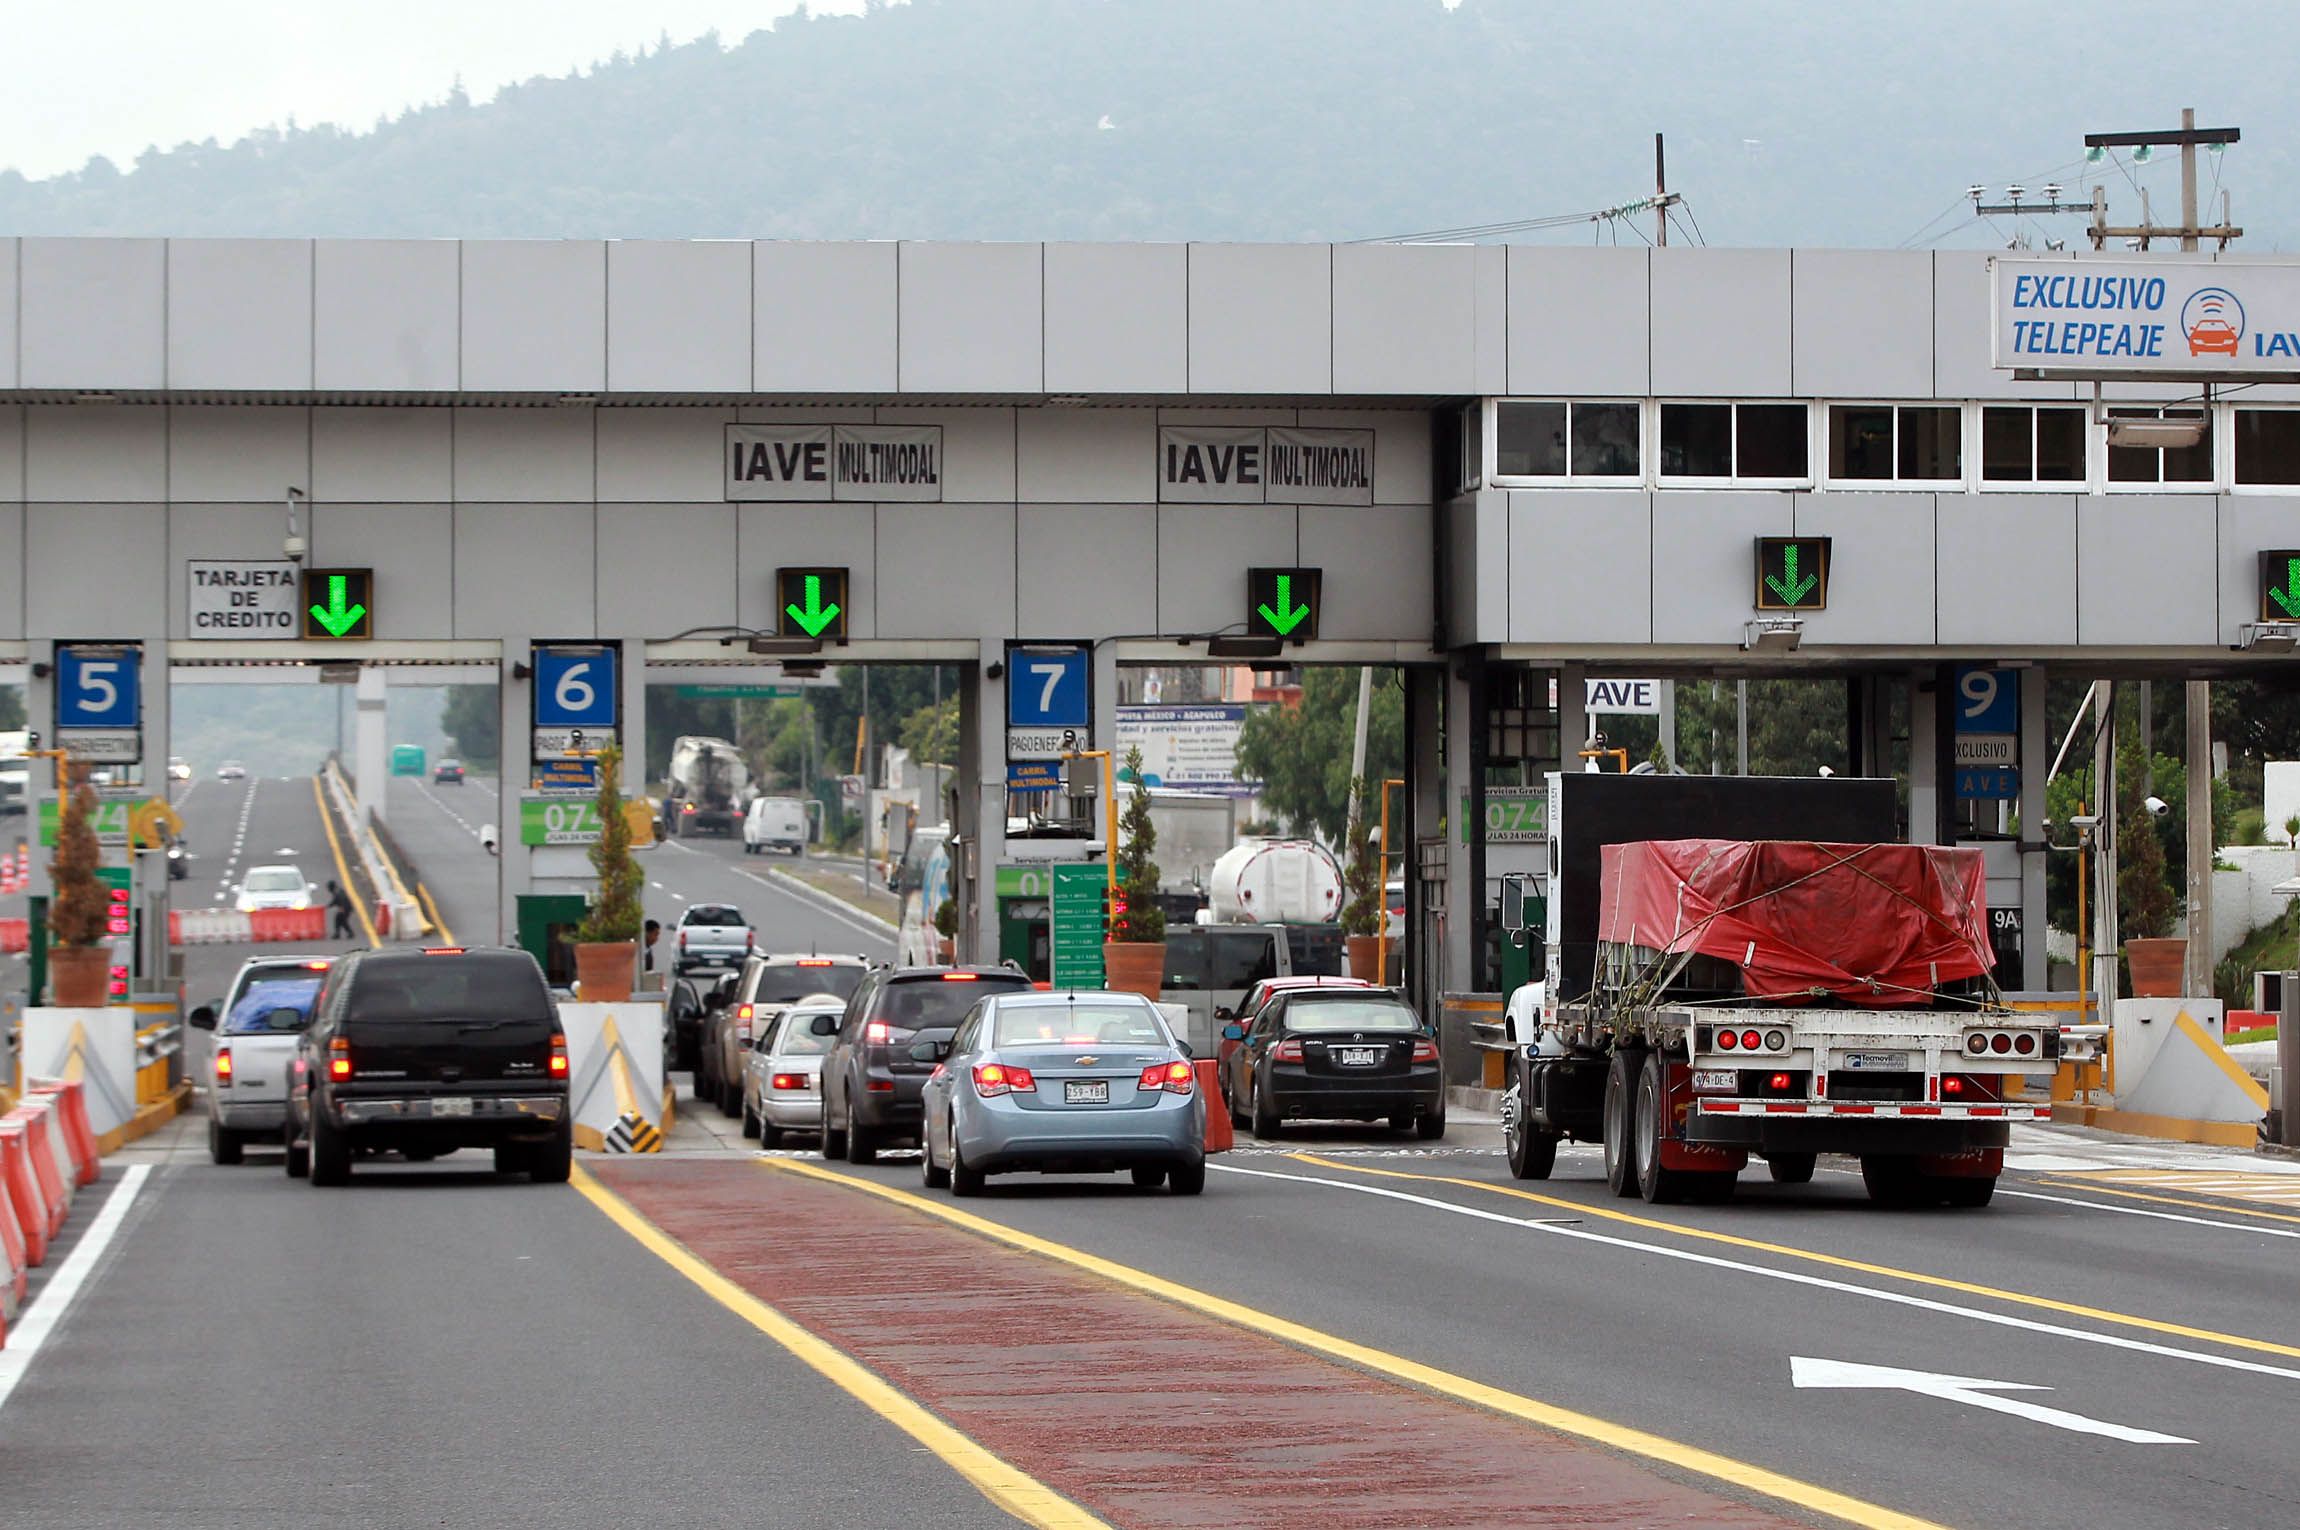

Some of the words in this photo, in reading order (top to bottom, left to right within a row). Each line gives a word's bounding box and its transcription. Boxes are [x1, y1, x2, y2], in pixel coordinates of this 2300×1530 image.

[2013, 275, 2166, 311] EXCLUSIVO
[2013, 321, 2165, 357] TELEPEAJE
[734, 442, 827, 481] IAVE
[838, 442, 937, 484] MULTIMODAL
[1167, 444, 1260, 484] IAVE
[1271, 445, 1369, 488] MULTIMODAL
[194, 570, 295, 587] TARJETA
[230, 591, 259, 607] DE
[196, 611, 292, 628] CREDITO
[76, 662, 118, 713] 5
[555, 663, 596, 711] 6
[1030, 664, 1065, 712] 7
[1961, 671, 1998, 718] 9
[1183, 711, 1226, 720] ACAPULCO
[1010, 777, 1058, 788] MULTIMODAL
[1017, 767, 1049, 776] CARRIL
[1994, 911, 2019, 928] 9A
